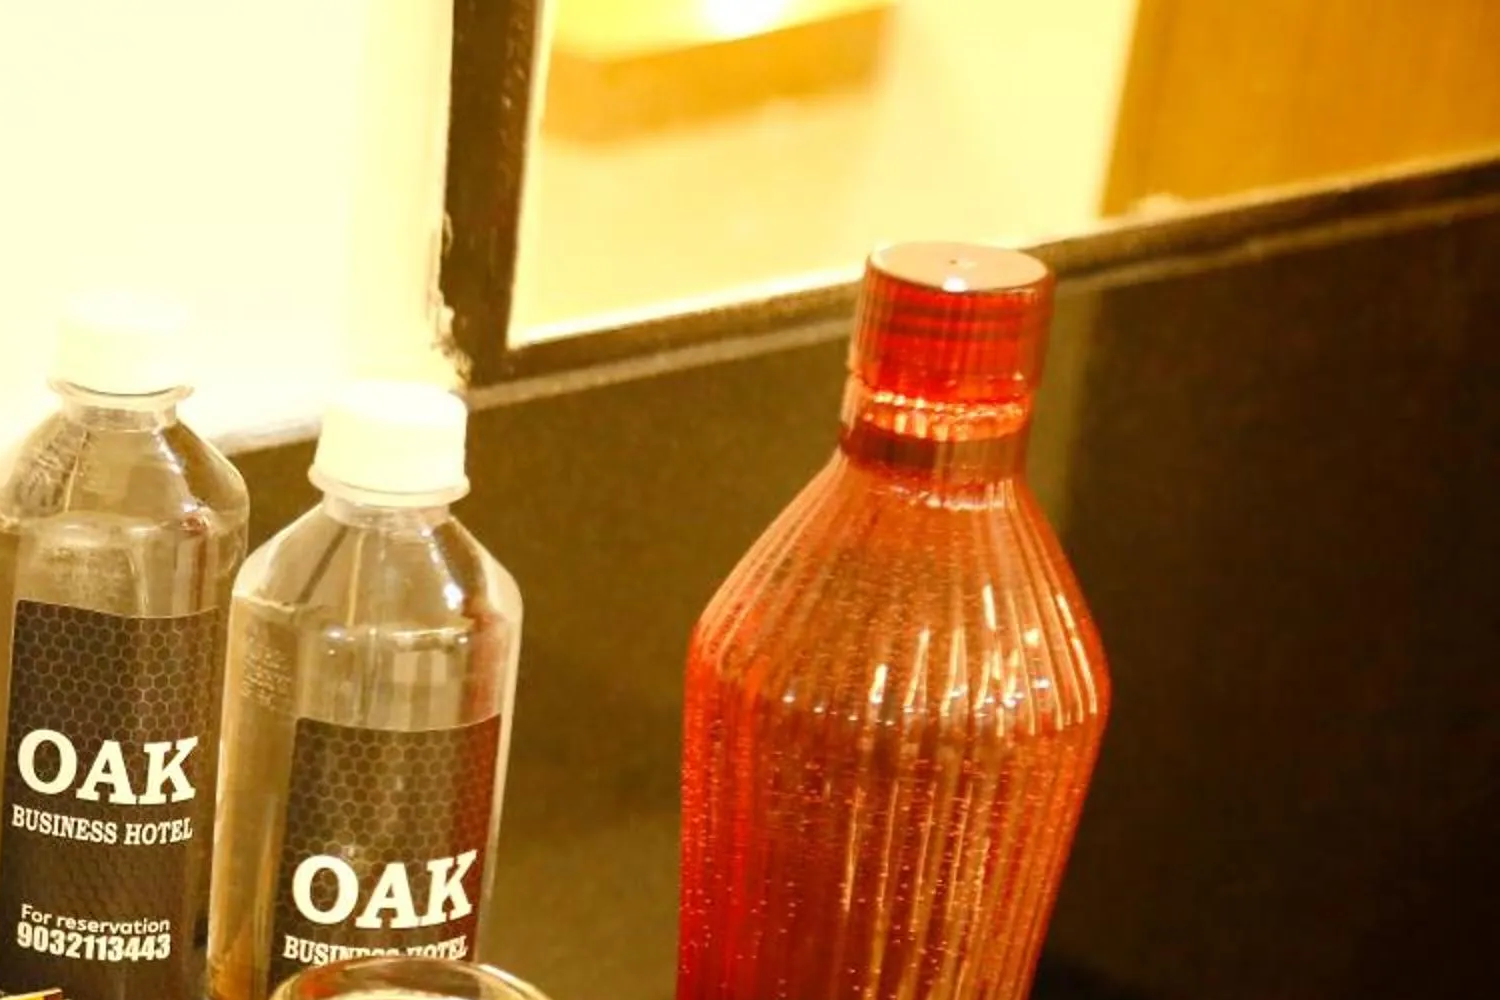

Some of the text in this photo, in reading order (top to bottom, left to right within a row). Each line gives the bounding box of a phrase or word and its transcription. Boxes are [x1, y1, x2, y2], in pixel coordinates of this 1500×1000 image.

[17, 728, 199, 805] OAK
[11, 803, 193, 846] BUSINESS HOTEL
[292, 848, 478, 929] OAK
[21, 903, 171, 936] For reservation
[17, 921, 171, 962] 9032113443
